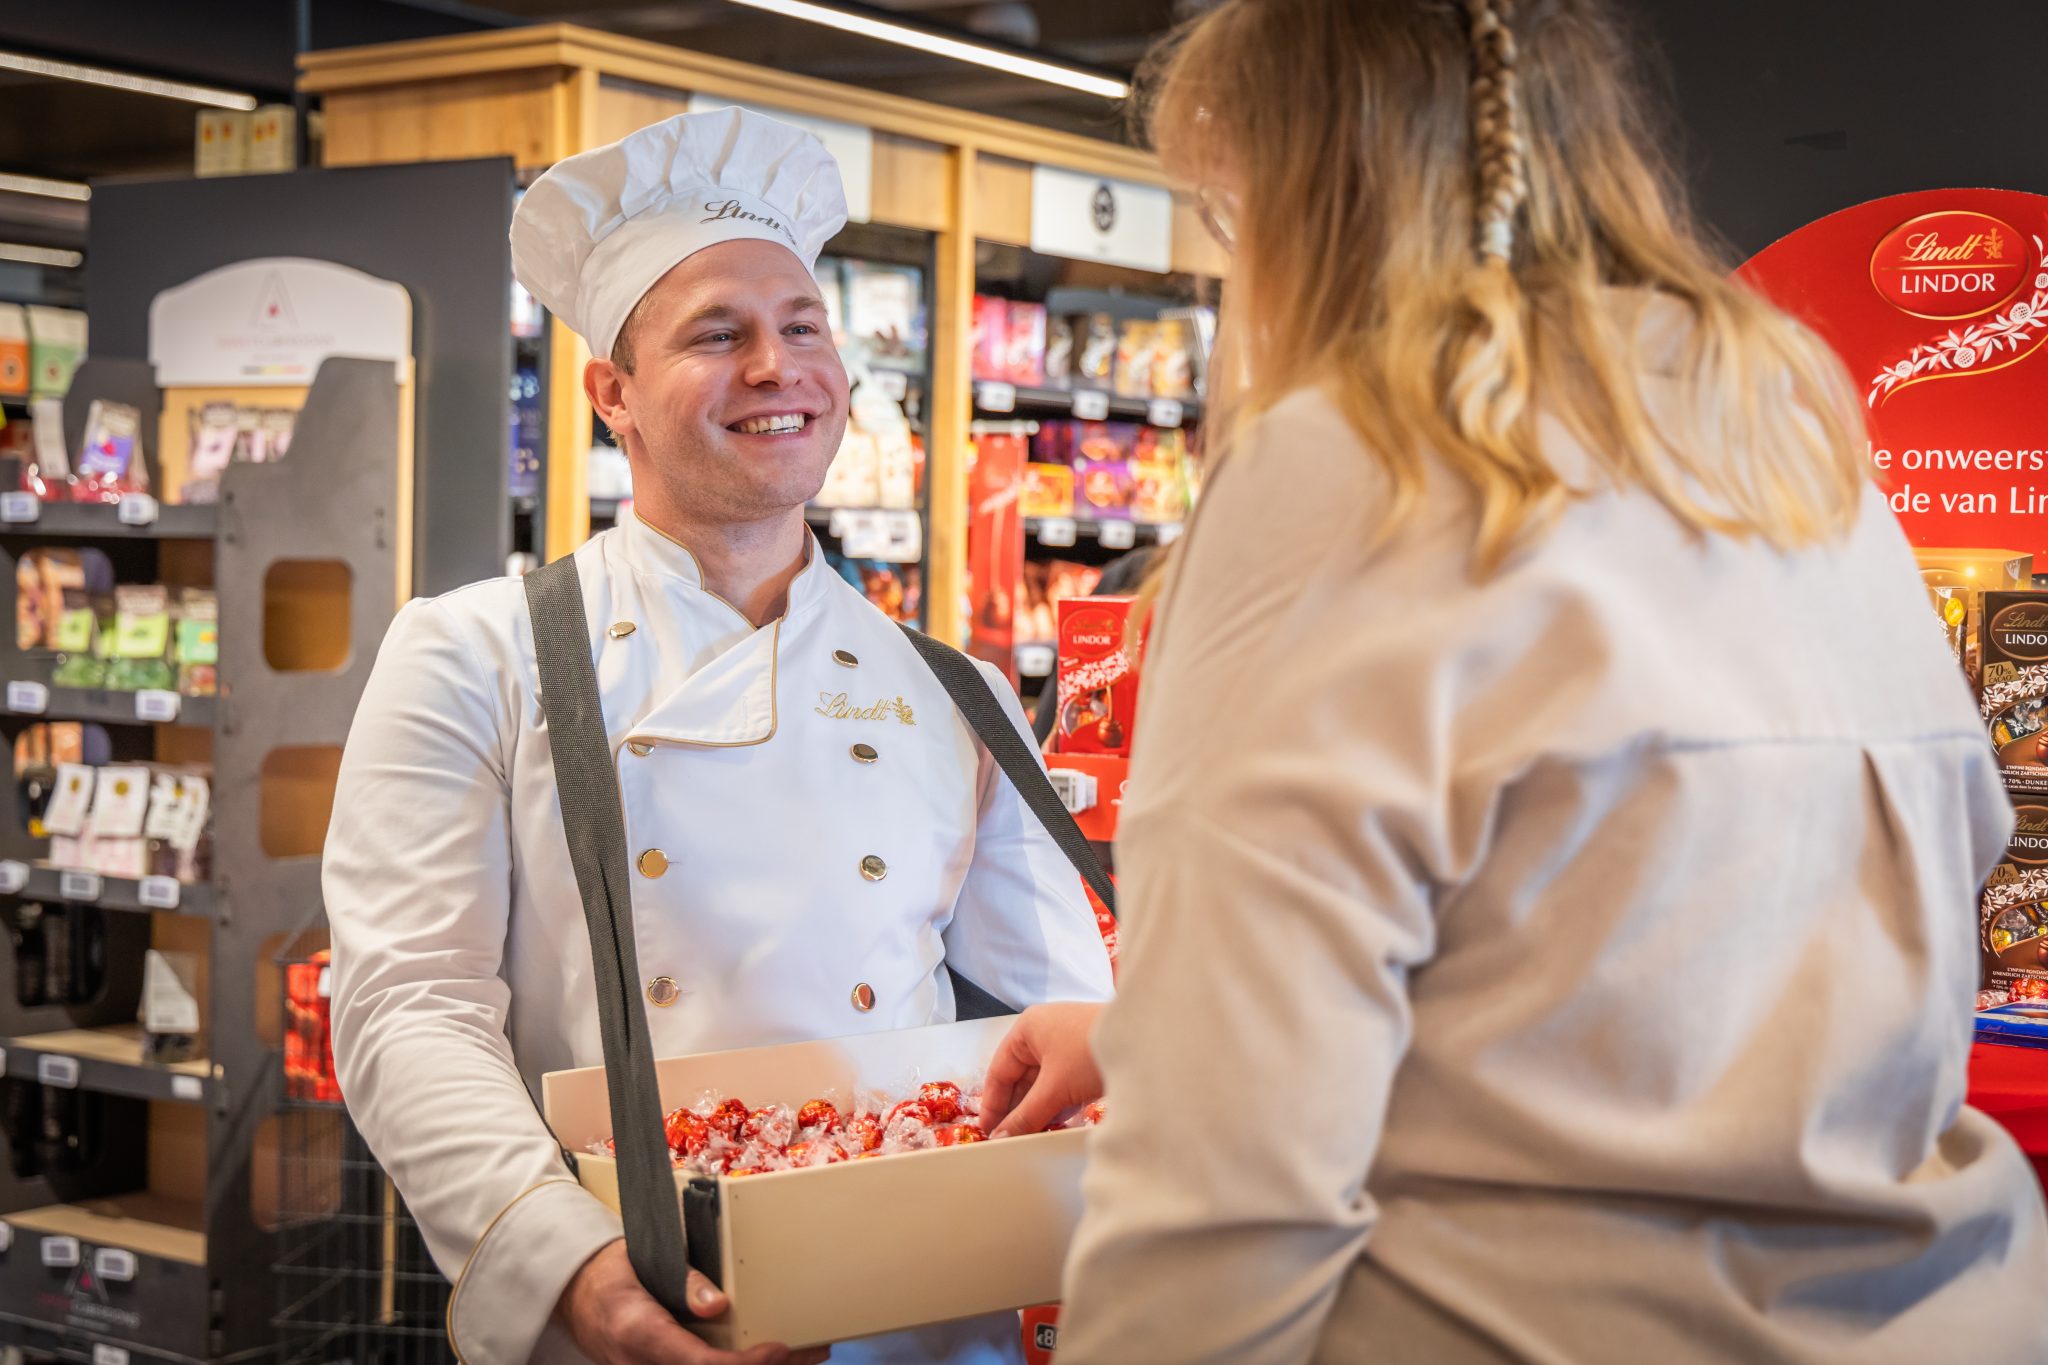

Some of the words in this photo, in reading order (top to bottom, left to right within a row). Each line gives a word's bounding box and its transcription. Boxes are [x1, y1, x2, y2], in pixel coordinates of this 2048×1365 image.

[1899, 232, 1983, 261] Lindt
[1901, 273, 1996, 294] LINDOR
[1940, 493, 1997, 514] van
[1072, 635, 1111, 646] LINDOR
[1988, 675, 2012, 684] CACAO
[814, 692, 892, 721] Lindt
